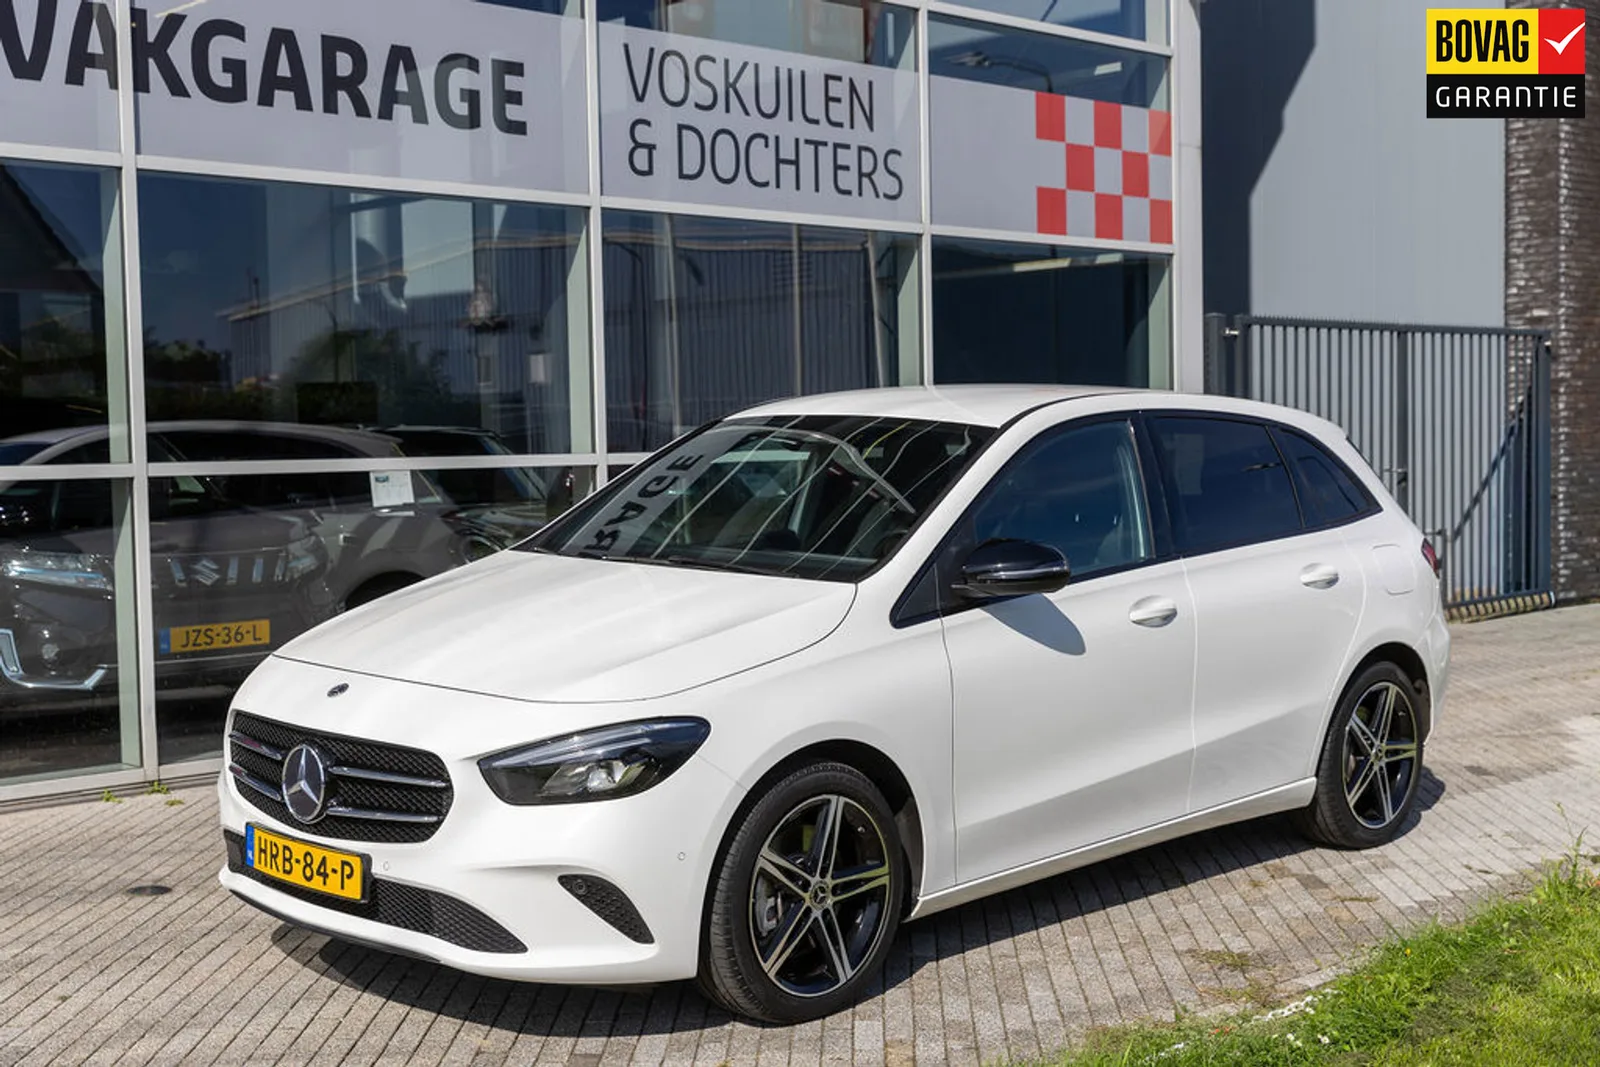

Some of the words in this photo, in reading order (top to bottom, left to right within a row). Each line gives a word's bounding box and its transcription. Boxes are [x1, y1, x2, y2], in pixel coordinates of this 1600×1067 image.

[0, 0, 528, 136] VAKGARAGE
[623, 42, 875, 132] VOSKUILEN
[627, 118, 657, 177] &
[677, 122, 903, 200] DOCHTERS
[181, 624, 262, 648] JZS-36-L
[258, 835, 354, 890] HRB-84-P
